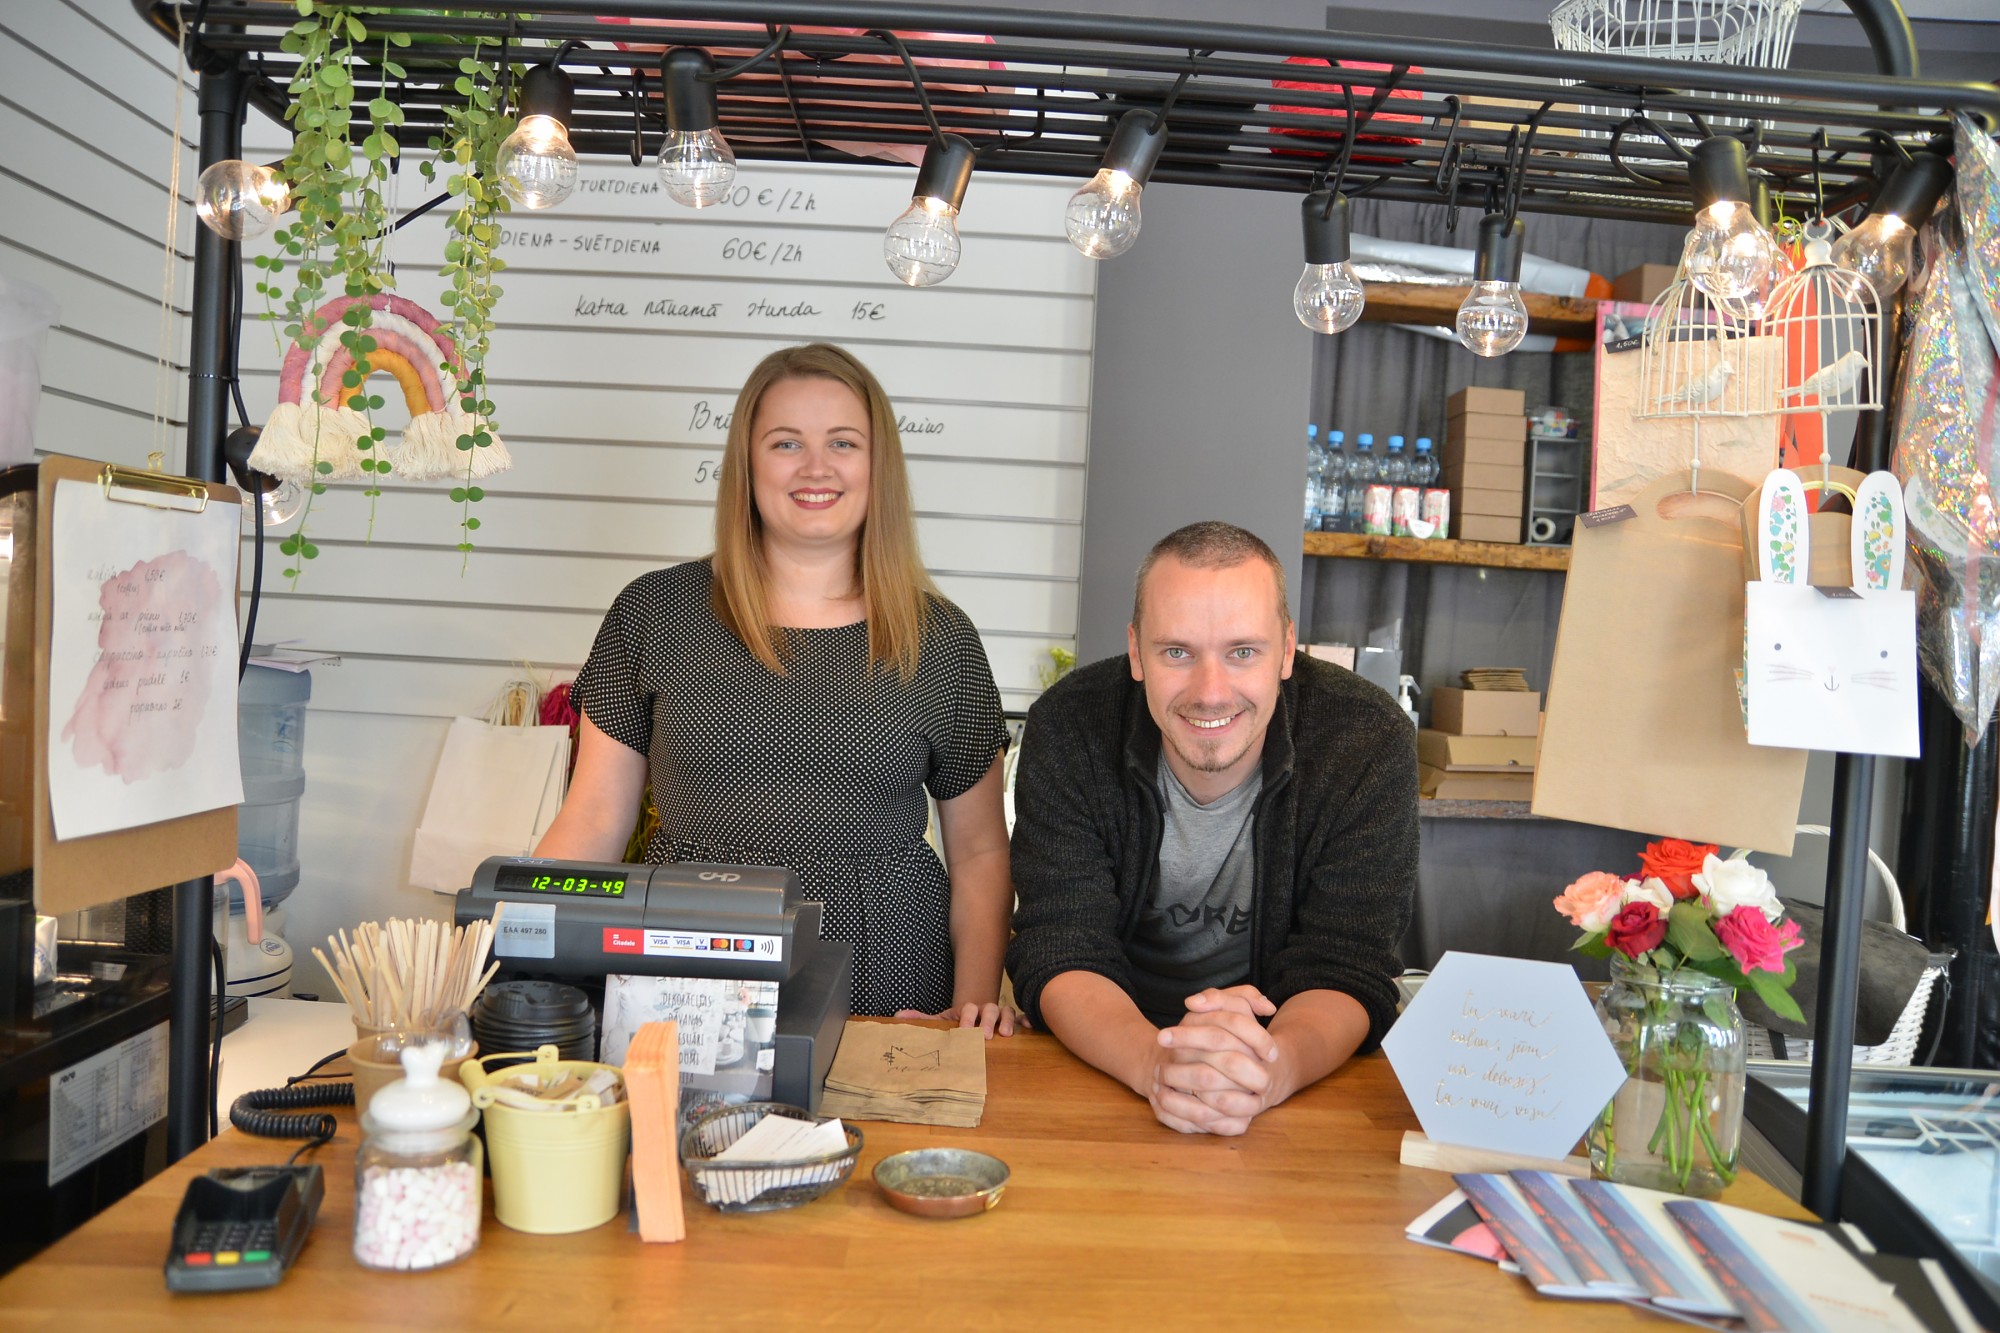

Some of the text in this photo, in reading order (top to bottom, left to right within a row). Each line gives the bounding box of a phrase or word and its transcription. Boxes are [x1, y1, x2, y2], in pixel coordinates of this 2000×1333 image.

[573, 234, 661, 253] SVĒTDIENA
[851, 301, 886, 321] 15€
[531, 876, 625, 895] 12-03-49
[503, 926, 547, 936] EAA 497 280
